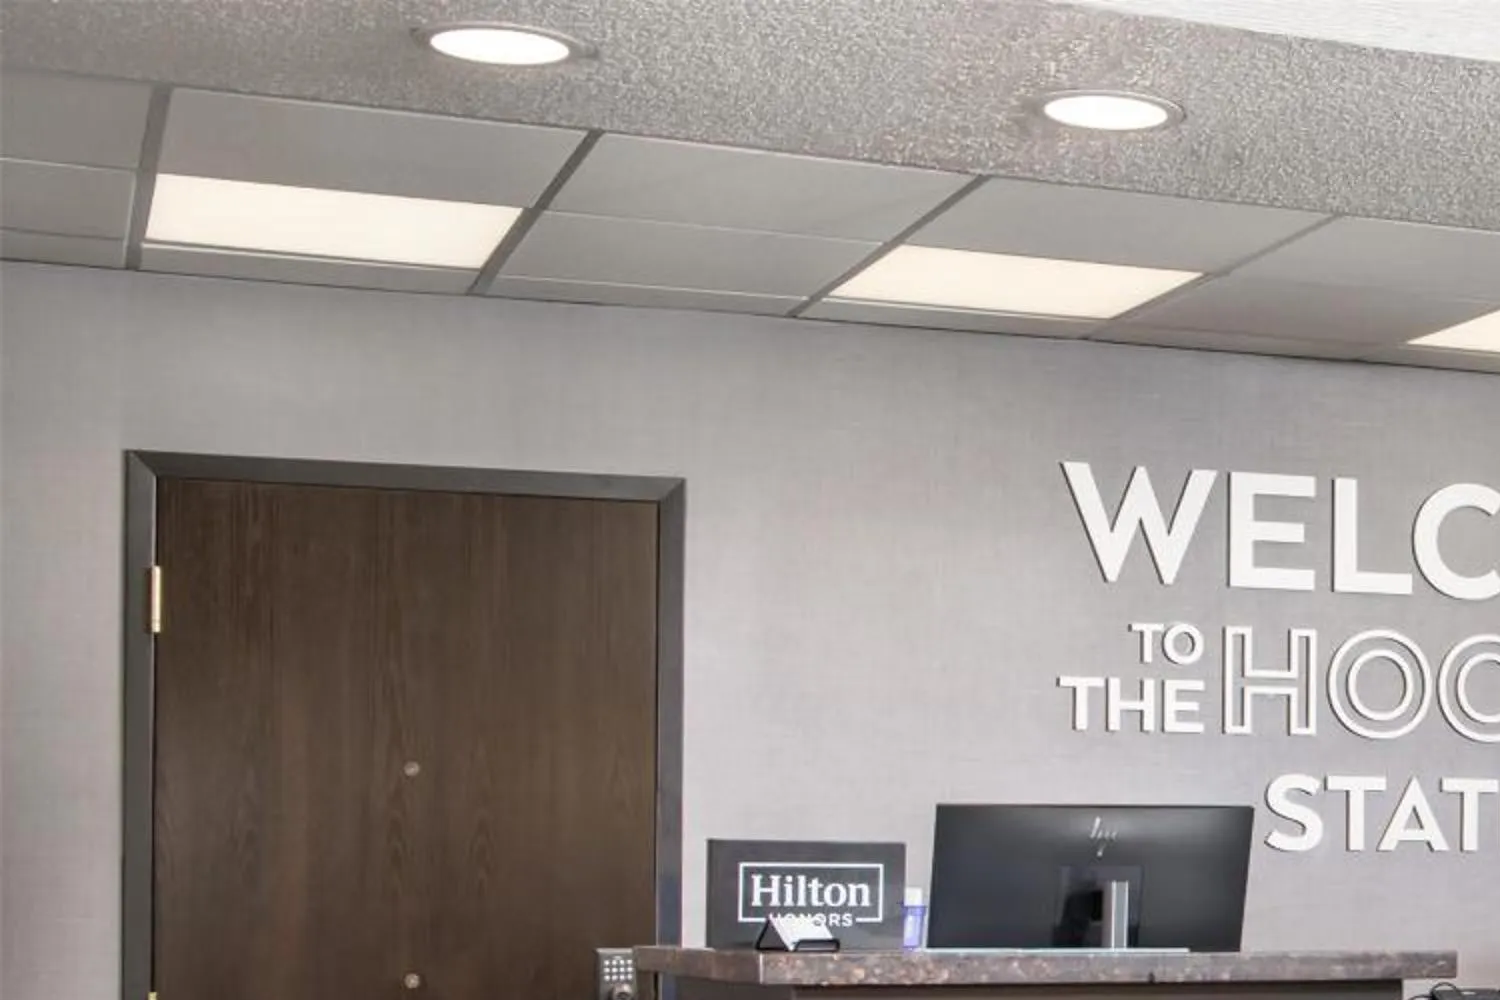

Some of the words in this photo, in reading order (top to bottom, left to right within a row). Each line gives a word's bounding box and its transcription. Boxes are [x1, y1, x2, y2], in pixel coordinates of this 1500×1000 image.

[1129, 622, 1205, 665] TO
[1057, 676, 1205, 733] THE
[751, 874, 871, 906] Hilton
[769, 912, 853, 927] ORS
